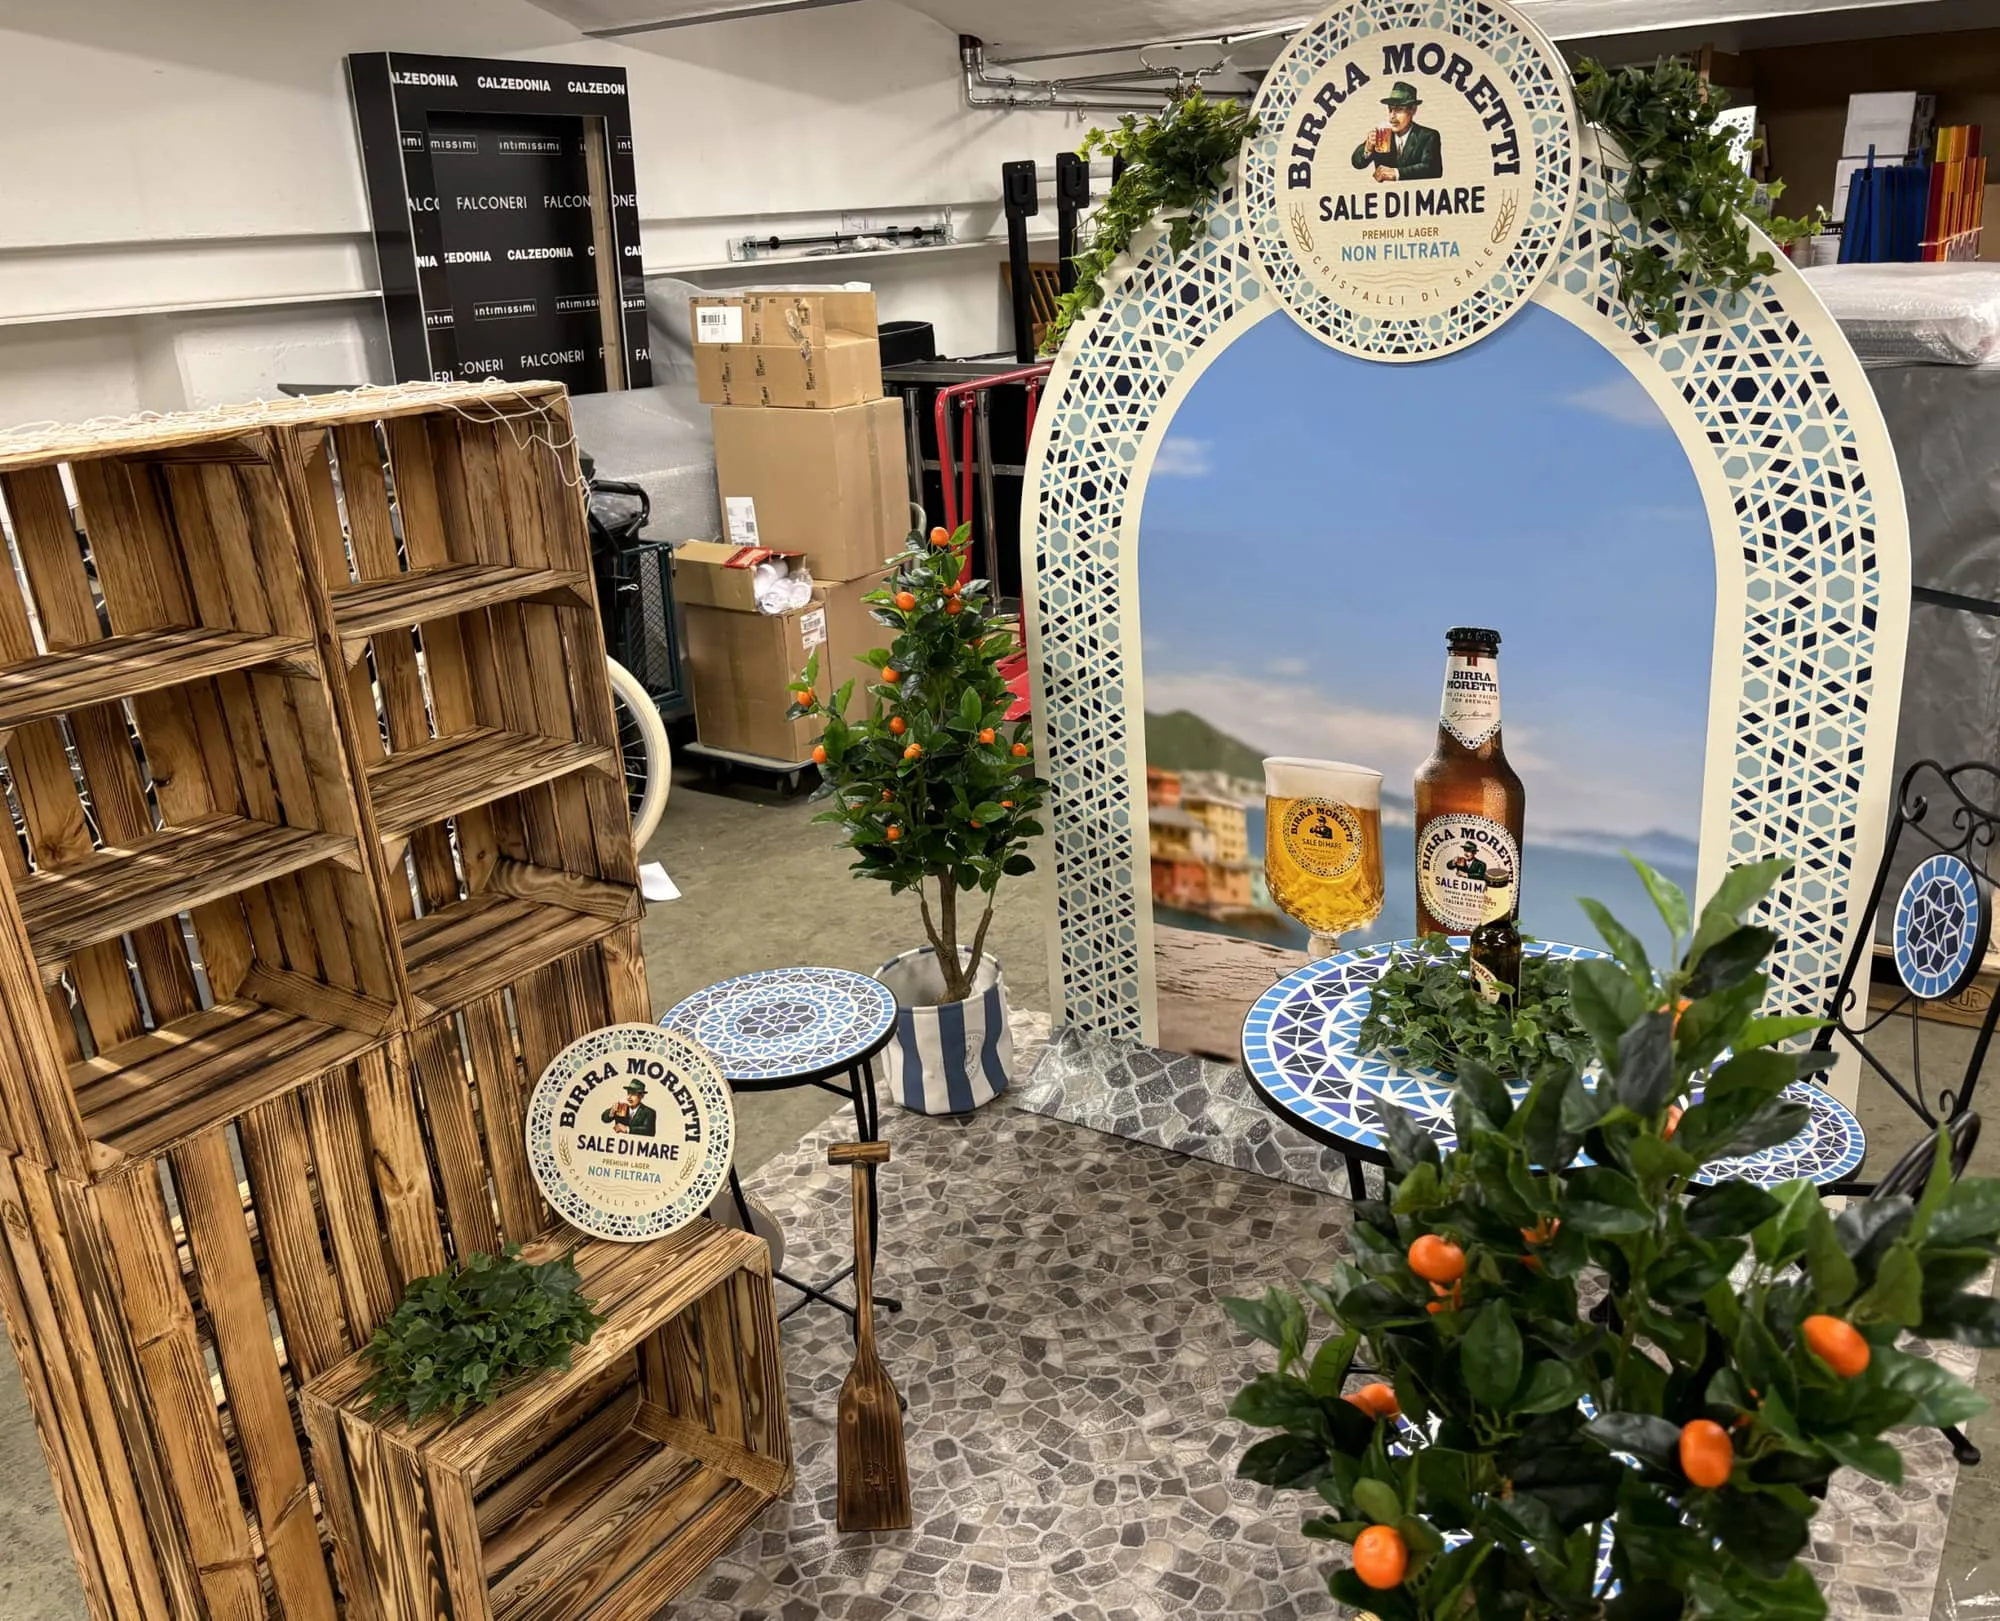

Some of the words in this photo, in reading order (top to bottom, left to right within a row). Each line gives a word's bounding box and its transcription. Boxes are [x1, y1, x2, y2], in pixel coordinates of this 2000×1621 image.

[477, 76, 551, 92] CALZEDONIA
[1287, 61, 1371, 191] BIRRA
[1382, 42, 1521, 176] MORETTI
[499, 140, 559, 151] intimissimi
[456, 195, 527, 210] FALCONERI
[1319, 192, 1378, 222] SALE
[1385, 189, 1410, 218] DI
[1415, 185, 1485, 216] MARE
[1361, 229, 1405, 240] PREMIUM
[1407, 226, 1439, 238] LAGER
[507, 247, 574, 260] CALZEDONIA
[1341, 244, 1377, 262] NON
[1383, 241, 1460, 260] FILTRATA
[1313, 256, 1405, 306] CRISTALLI
[1422, 288, 1439, 302] DI
[1454, 246, 1493, 287] SALE
[475, 304, 535, 316] intimissimi
[520, 349, 584, 368] FALCONERI
[1452, 670, 1492, 681] BIRRA
[1446, 680, 1497, 692] MORETTI
[1422, 828, 1456, 871] BIRRA
[1460, 827, 1514, 884] MORETTI
[1435, 876, 1459, 890] SALE
[1461, 881, 1472, 892] DI
[559, 1061, 619, 1129] BIRRA
[626, 1057, 701, 1143] MORETTI
[577, 1134, 615, 1153] SALE
[618, 1137, 635, 1156] DI
[637, 1139, 680, 1161] MARE
[601, 1158, 629, 1168] PREMIUM
[630, 1161, 650, 1169] LAGER
[587, 1165, 611, 1177] NON
[614, 1167, 662, 1184] FILTRATA
